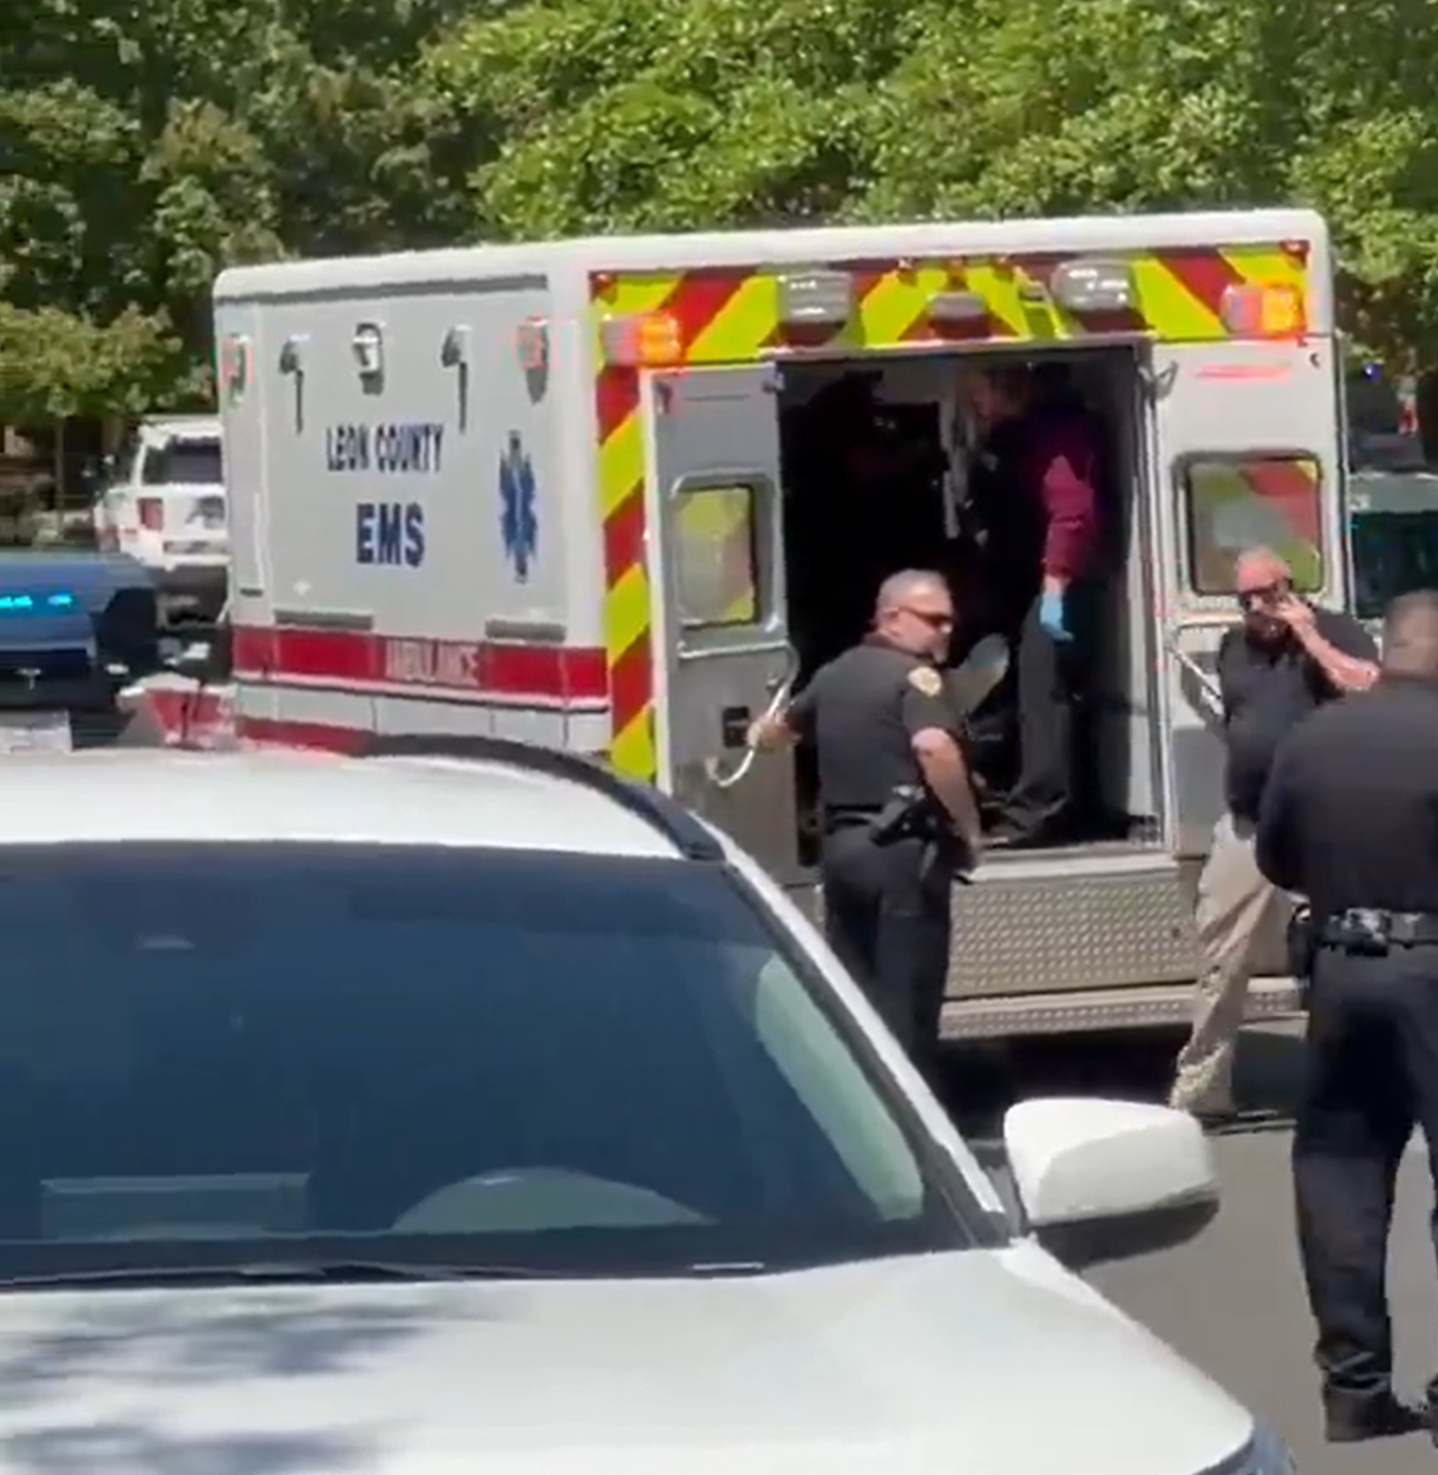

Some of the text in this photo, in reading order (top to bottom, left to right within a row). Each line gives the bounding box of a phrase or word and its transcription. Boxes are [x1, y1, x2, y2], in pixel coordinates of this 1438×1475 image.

[327, 423, 444, 473] LEON COUNTY
[355, 502, 426, 567] EMS
